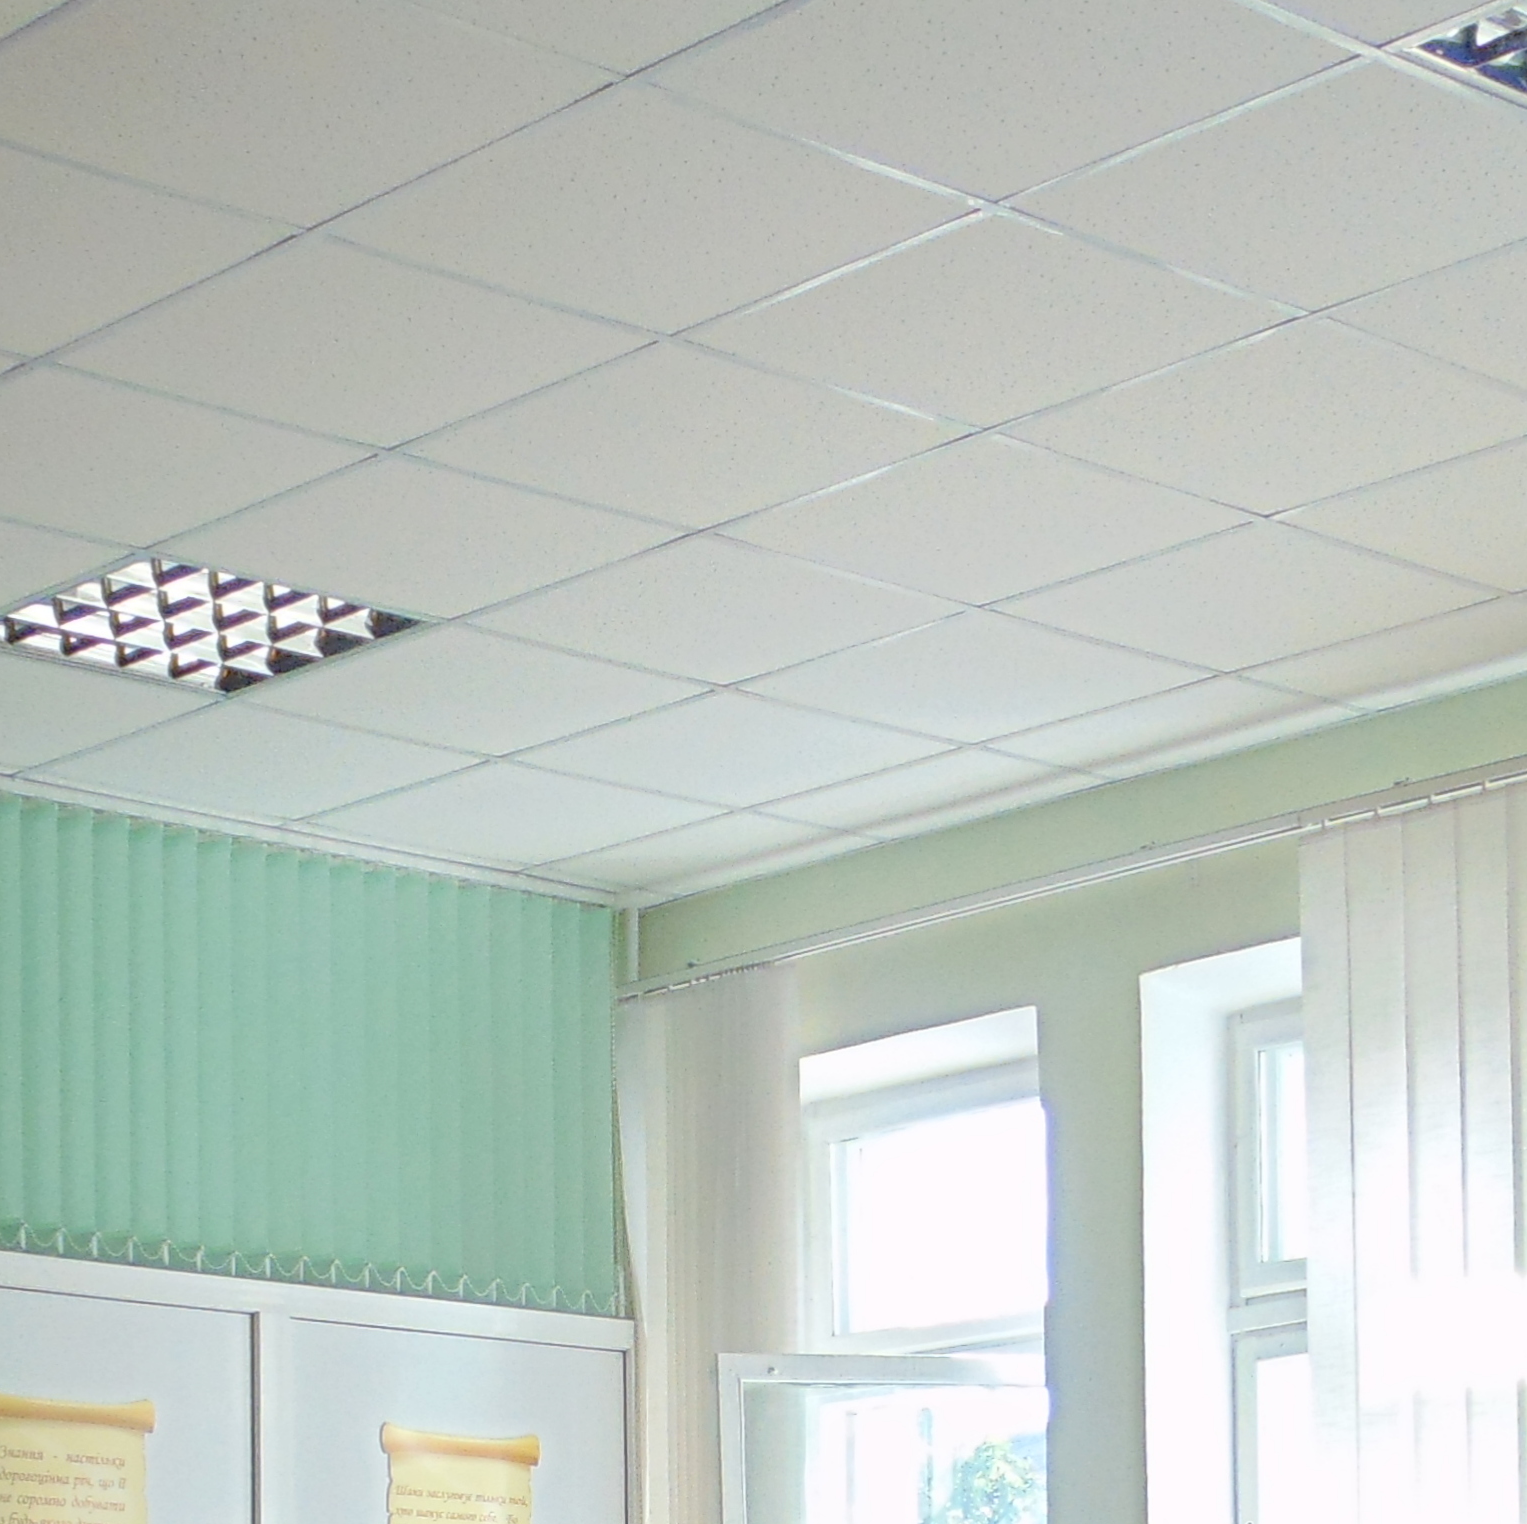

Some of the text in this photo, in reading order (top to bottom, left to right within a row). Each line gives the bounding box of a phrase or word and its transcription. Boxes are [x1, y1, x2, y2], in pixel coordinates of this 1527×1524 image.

[0, 1444, 44, 1461] Знання
[66, 1452, 126, 1470] настільки
[98, 1478, 115, 1491] що
[16, 1494, 67, 1509] соромно
[71, 1495, 126, 1514] добувати
